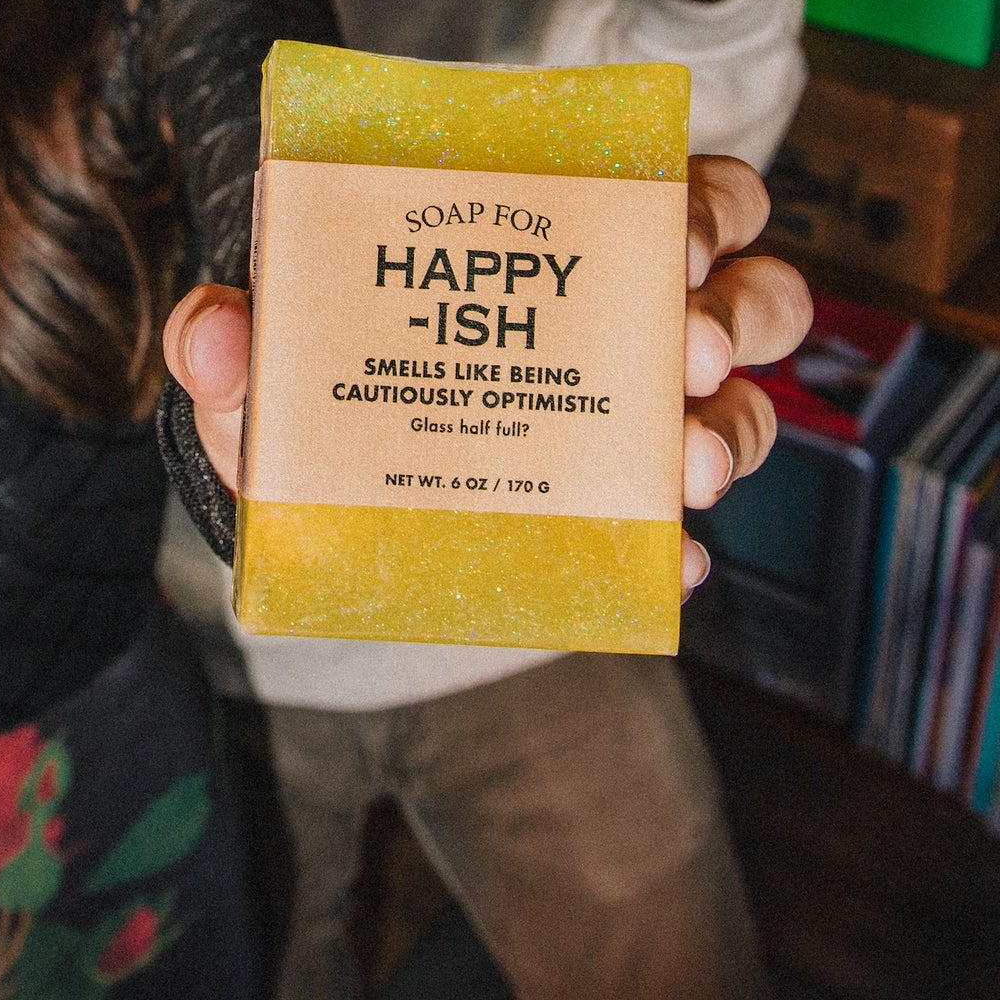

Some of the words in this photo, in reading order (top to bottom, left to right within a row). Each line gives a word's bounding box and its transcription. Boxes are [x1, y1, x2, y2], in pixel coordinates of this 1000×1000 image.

[405, 202, 484, 234] SOAP
[493, 204, 552, 241] FOR
[375, 245, 582, 297] HAPPY
[409, 302, 537, 350] -ISH
[364, 358, 446, 380] SMELLS
[455, 363, 501, 383] LIKE
[510, 366, 582, 387] BEING
[332, 383, 474, 408] CAUTIOUSLY
[482, 390, 611, 415] OPTIMISTIC
[410, 417, 454, 434] Glass
[460, 419, 491, 436] half
[496, 421, 530, 438] full?
[385, 473, 415, 487] NET
[418, 475, 446, 489] WT.
[451, 477, 461, 490] 6
[466, 477, 489, 491] OZ
[507, 479, 534, 493] 170
[538, 481, 551, 494] G
